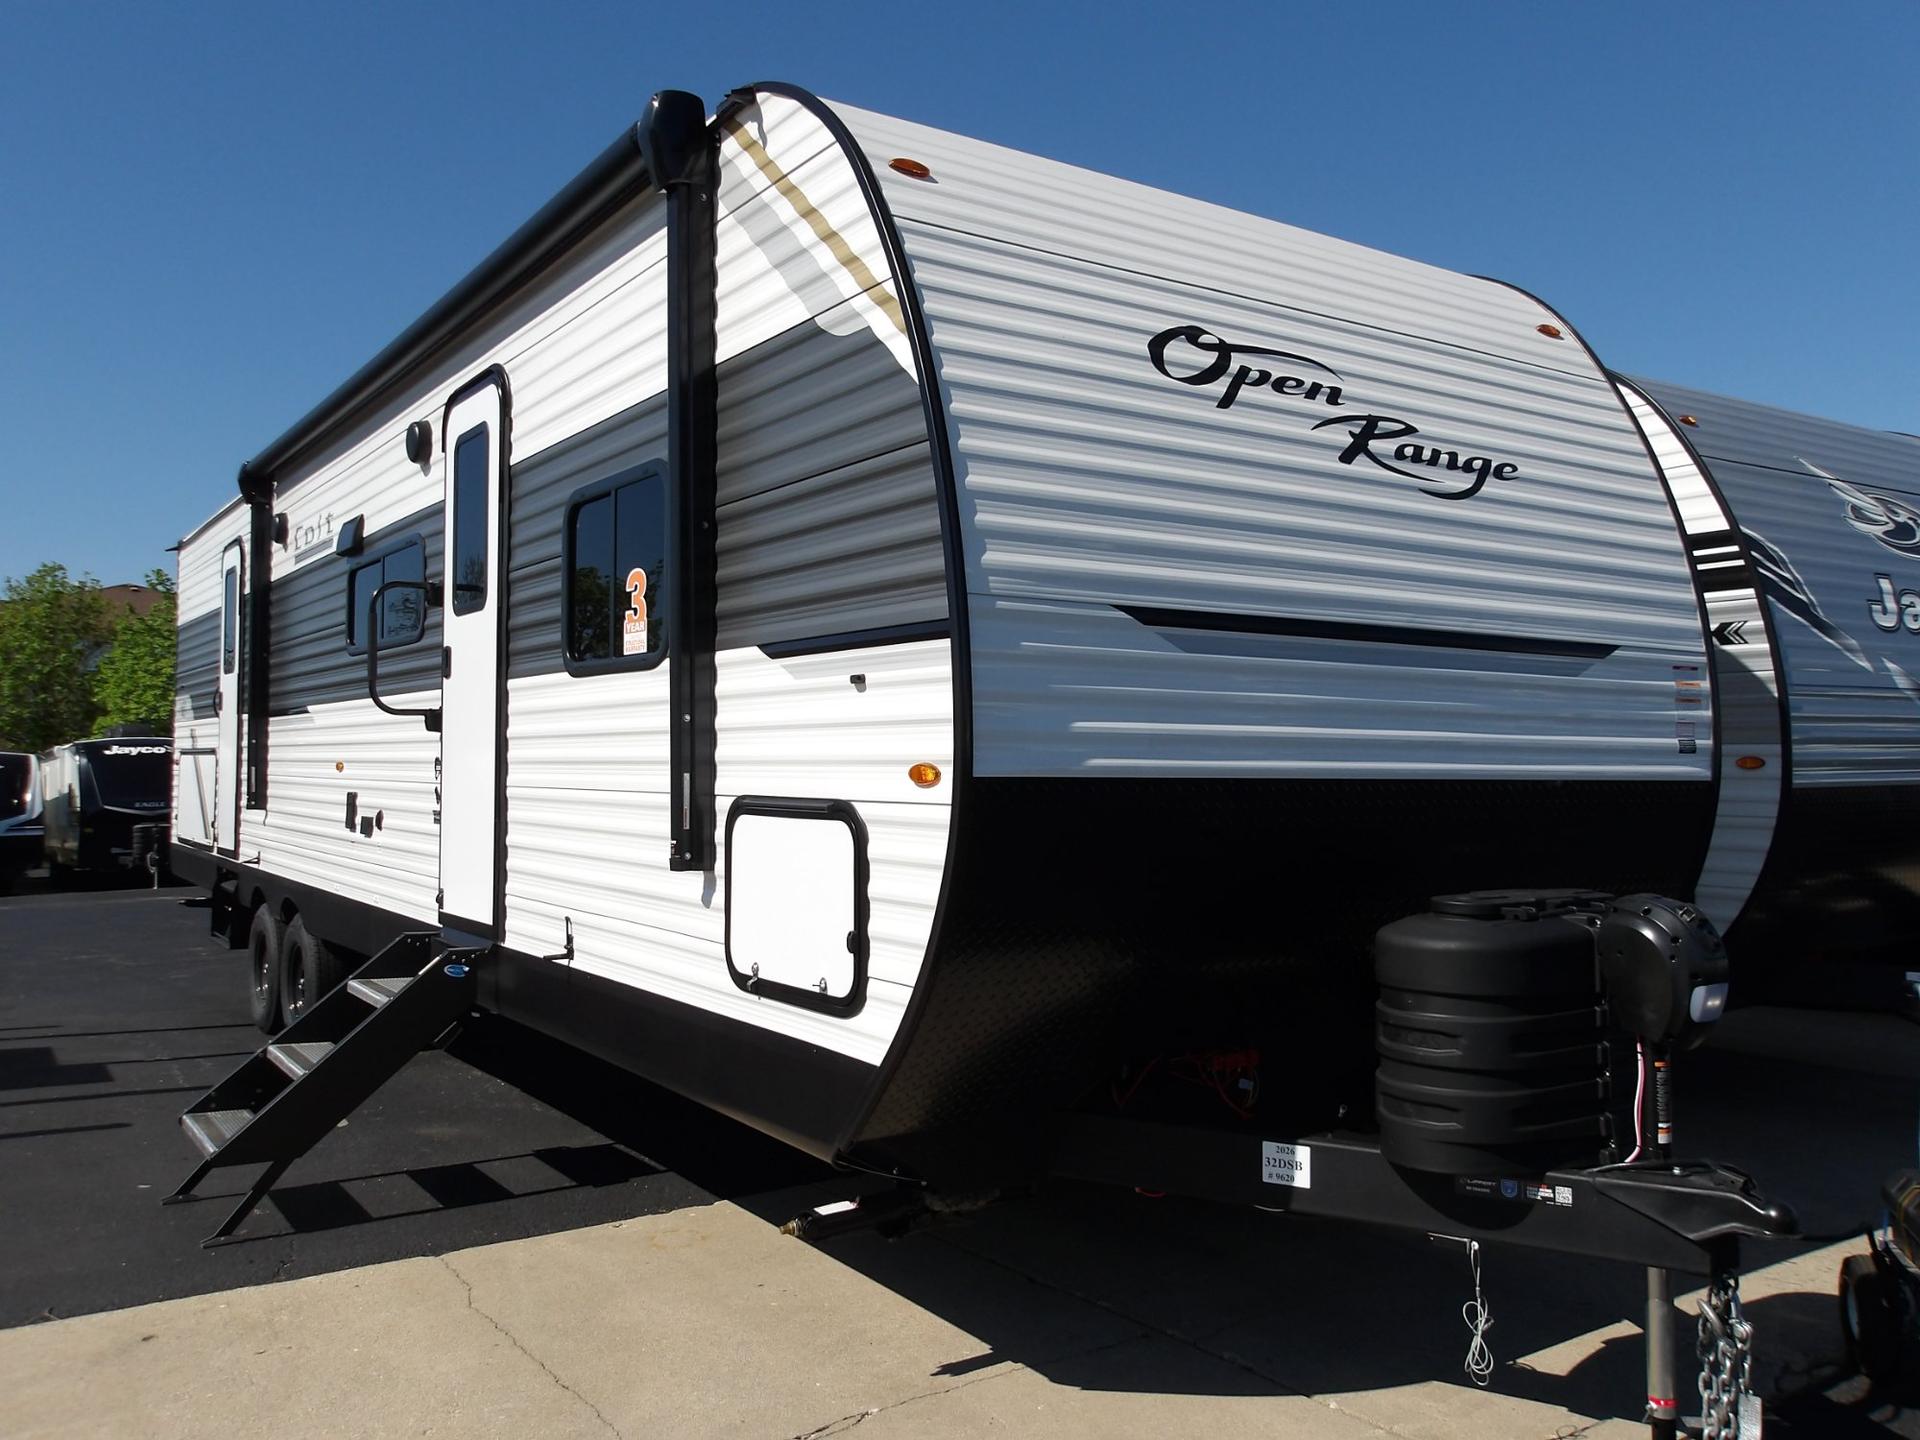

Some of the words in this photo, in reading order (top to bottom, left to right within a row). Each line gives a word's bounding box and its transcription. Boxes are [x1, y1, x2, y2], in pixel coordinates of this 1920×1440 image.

[1148, 325, 1345, 409] Open
[1311, 414, 1519, 500] Range
[625, 568, 647, 623] 3
[103, 745, 166, 755] Jayco
[1276, 1145, 1295, 1155] 2026
[1264, 1157, 1303, 1171] 32DSB
[1275, 1173, 1295, 1183] 9620
